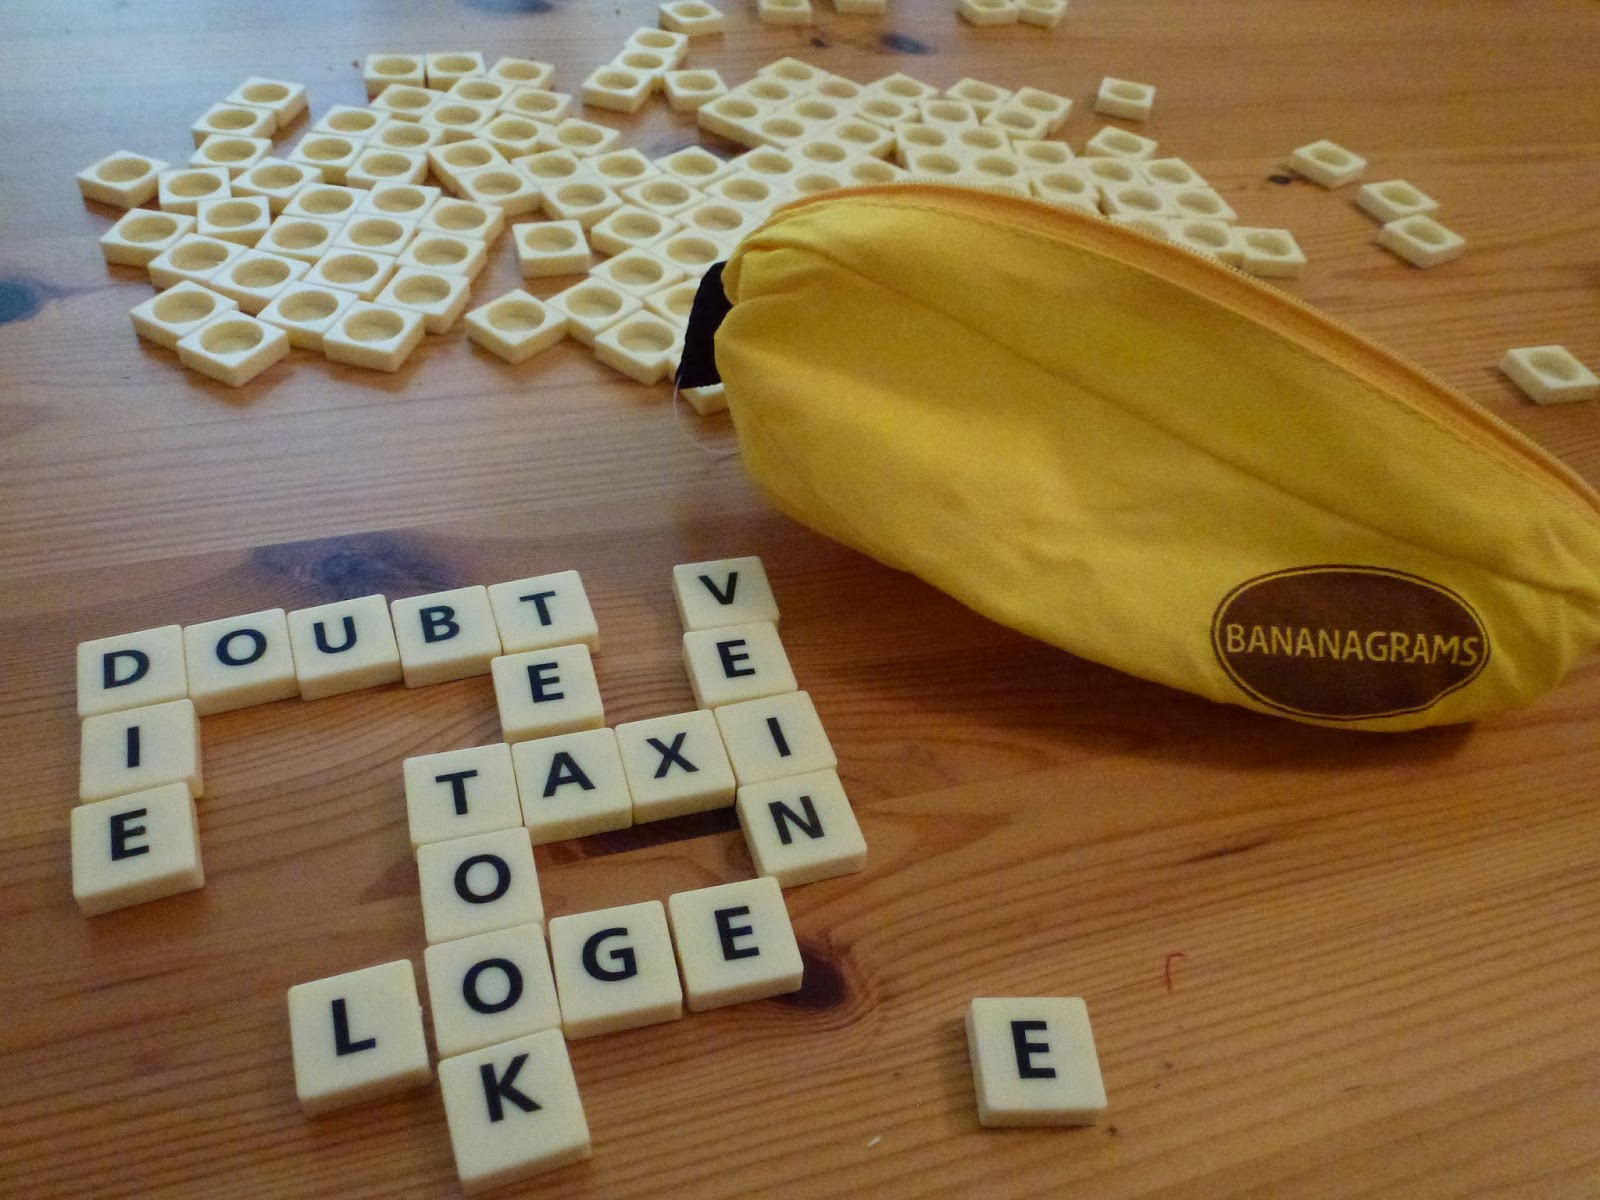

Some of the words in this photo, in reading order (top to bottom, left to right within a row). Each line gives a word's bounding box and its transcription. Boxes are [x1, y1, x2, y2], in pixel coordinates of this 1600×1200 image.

[104, 591, 556, 690] DOUBT
[1226, 623, 1479, 666] BANANAGRAMS
[104, 650, 150, 861] DIE
[435, 717, 791, 815] TAXI
[698, 572, 825, 845] VEIN
[331, 906, 760, 1057] LOGE
[435, 770, 542, 1123] TOOK
[1010, 1021, 1056, 1079] E
